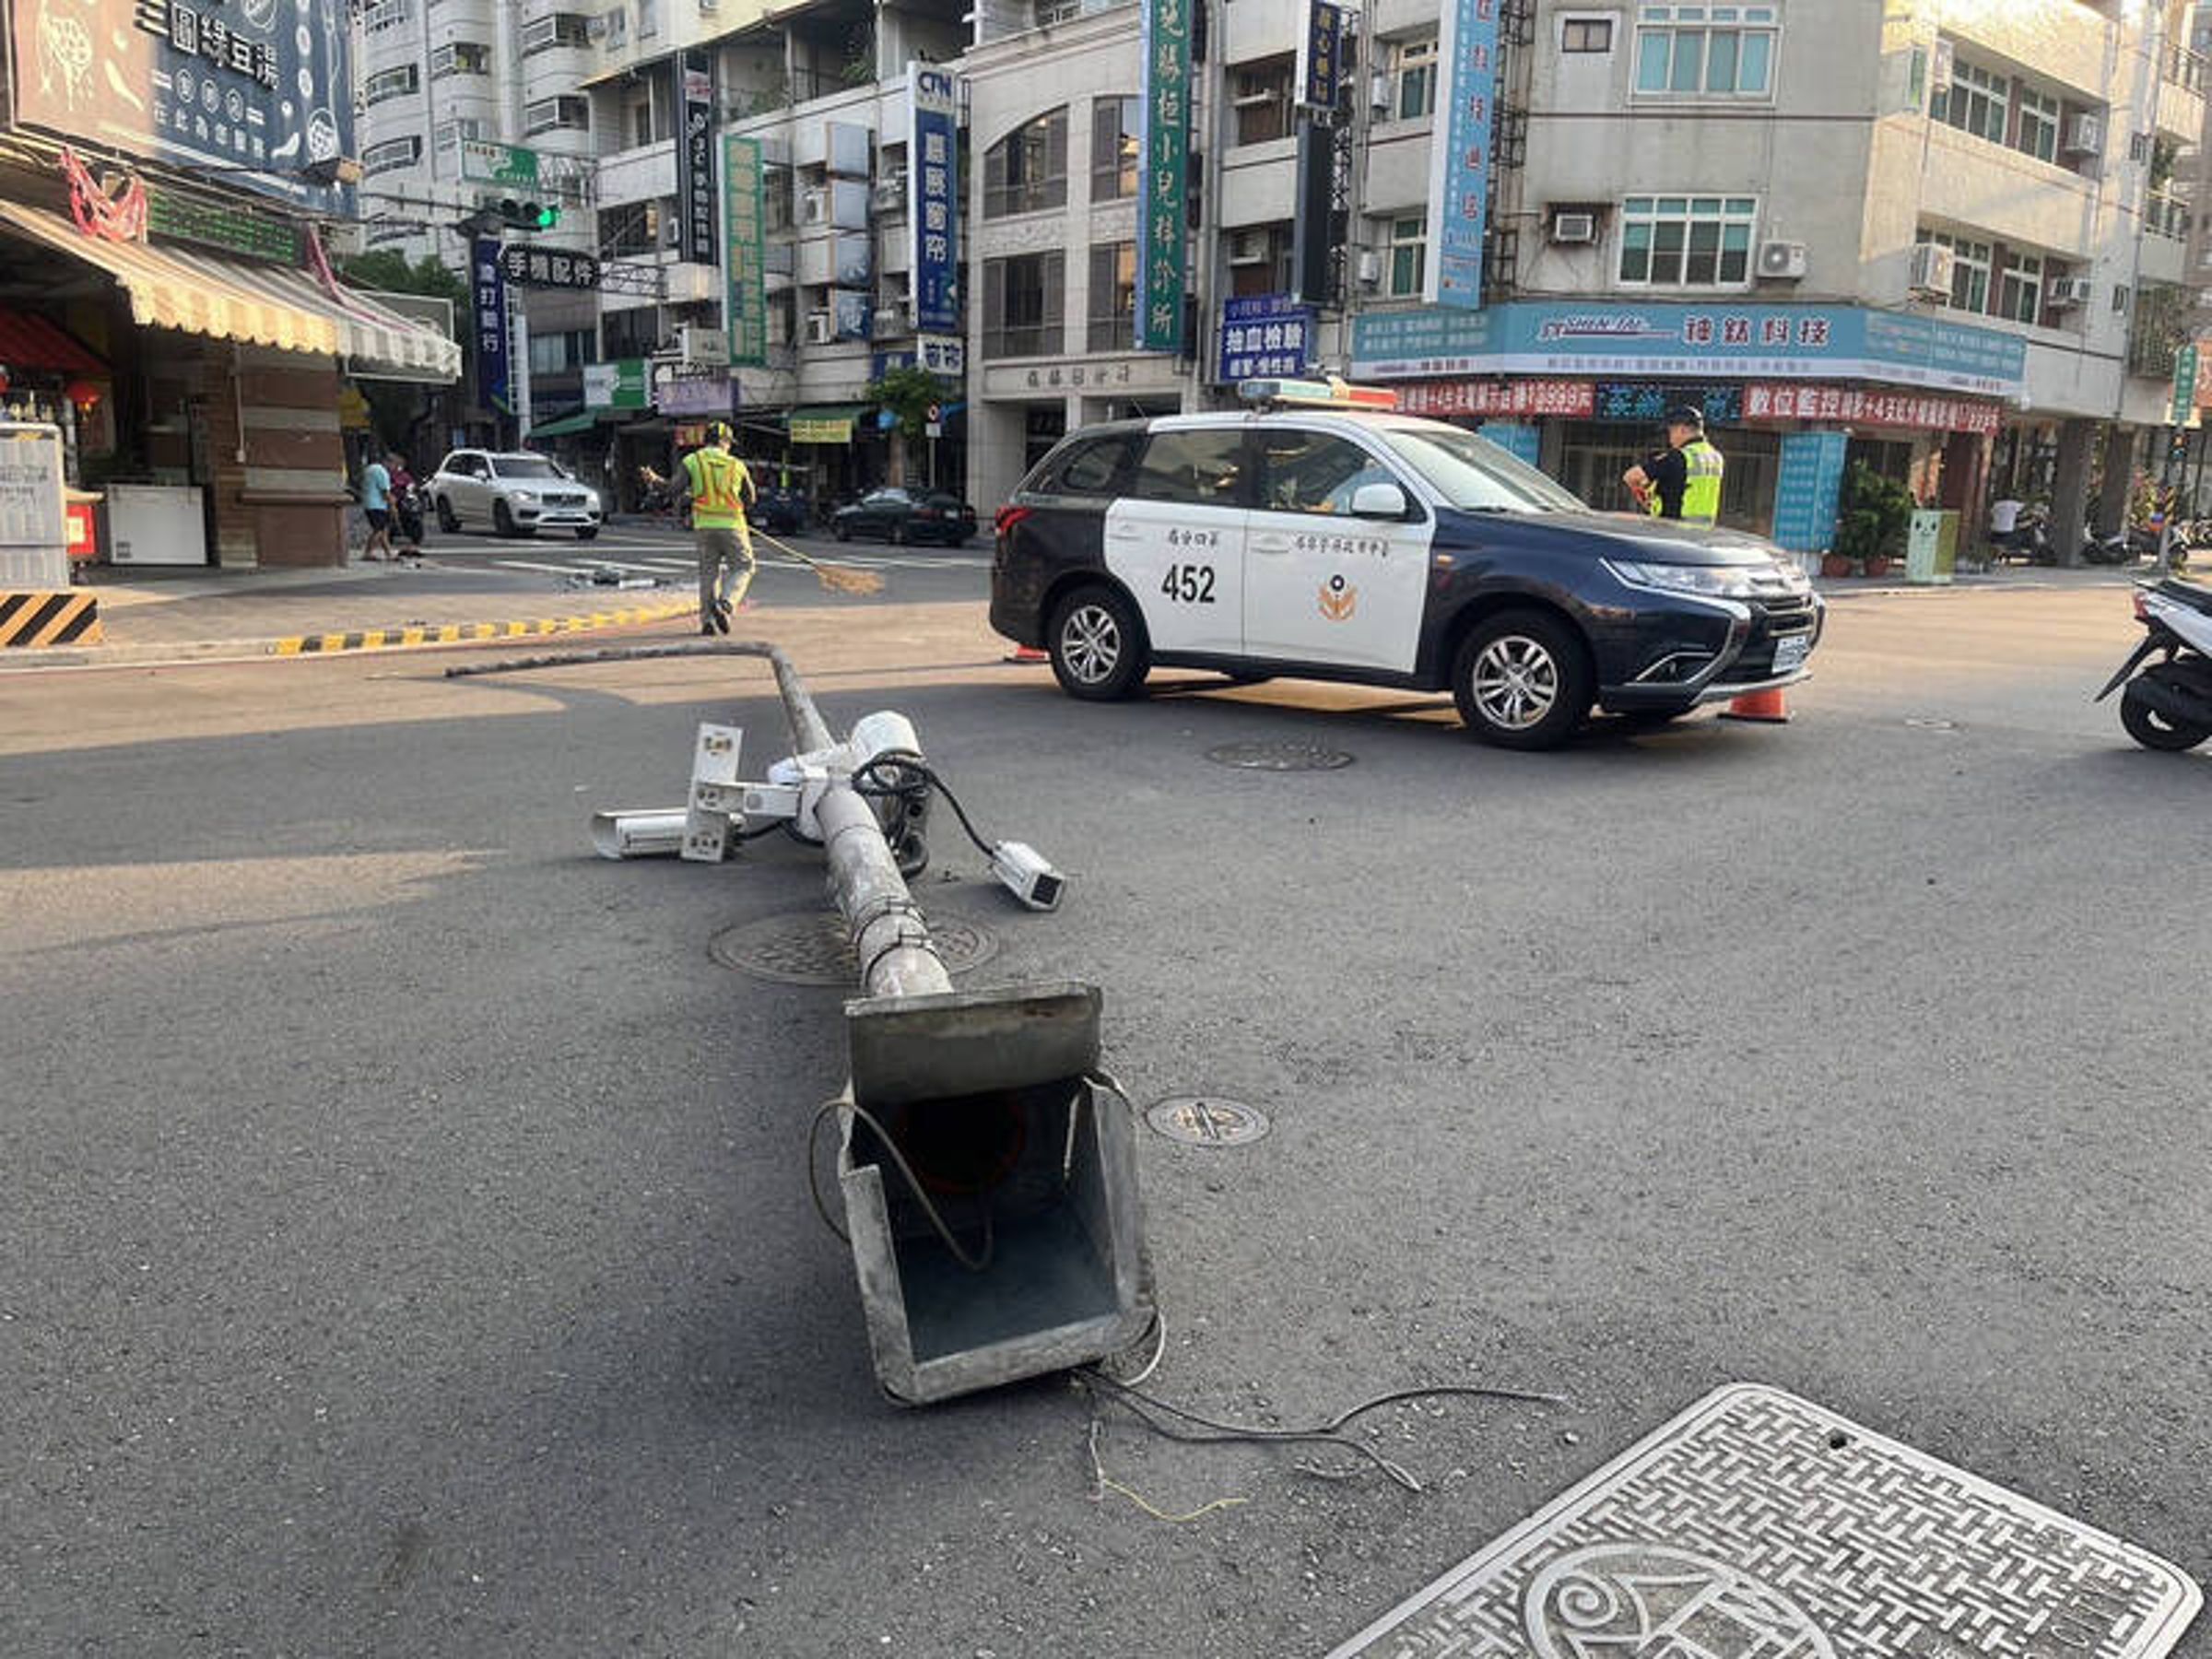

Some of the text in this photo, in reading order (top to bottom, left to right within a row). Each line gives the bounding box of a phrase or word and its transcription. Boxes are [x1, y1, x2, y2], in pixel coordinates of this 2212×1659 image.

[507, 250, 592, 285] 手機配件
[1226, 323, 1302, 355] 抽血檢驗
[1160, 563, 1217, 604] 452
